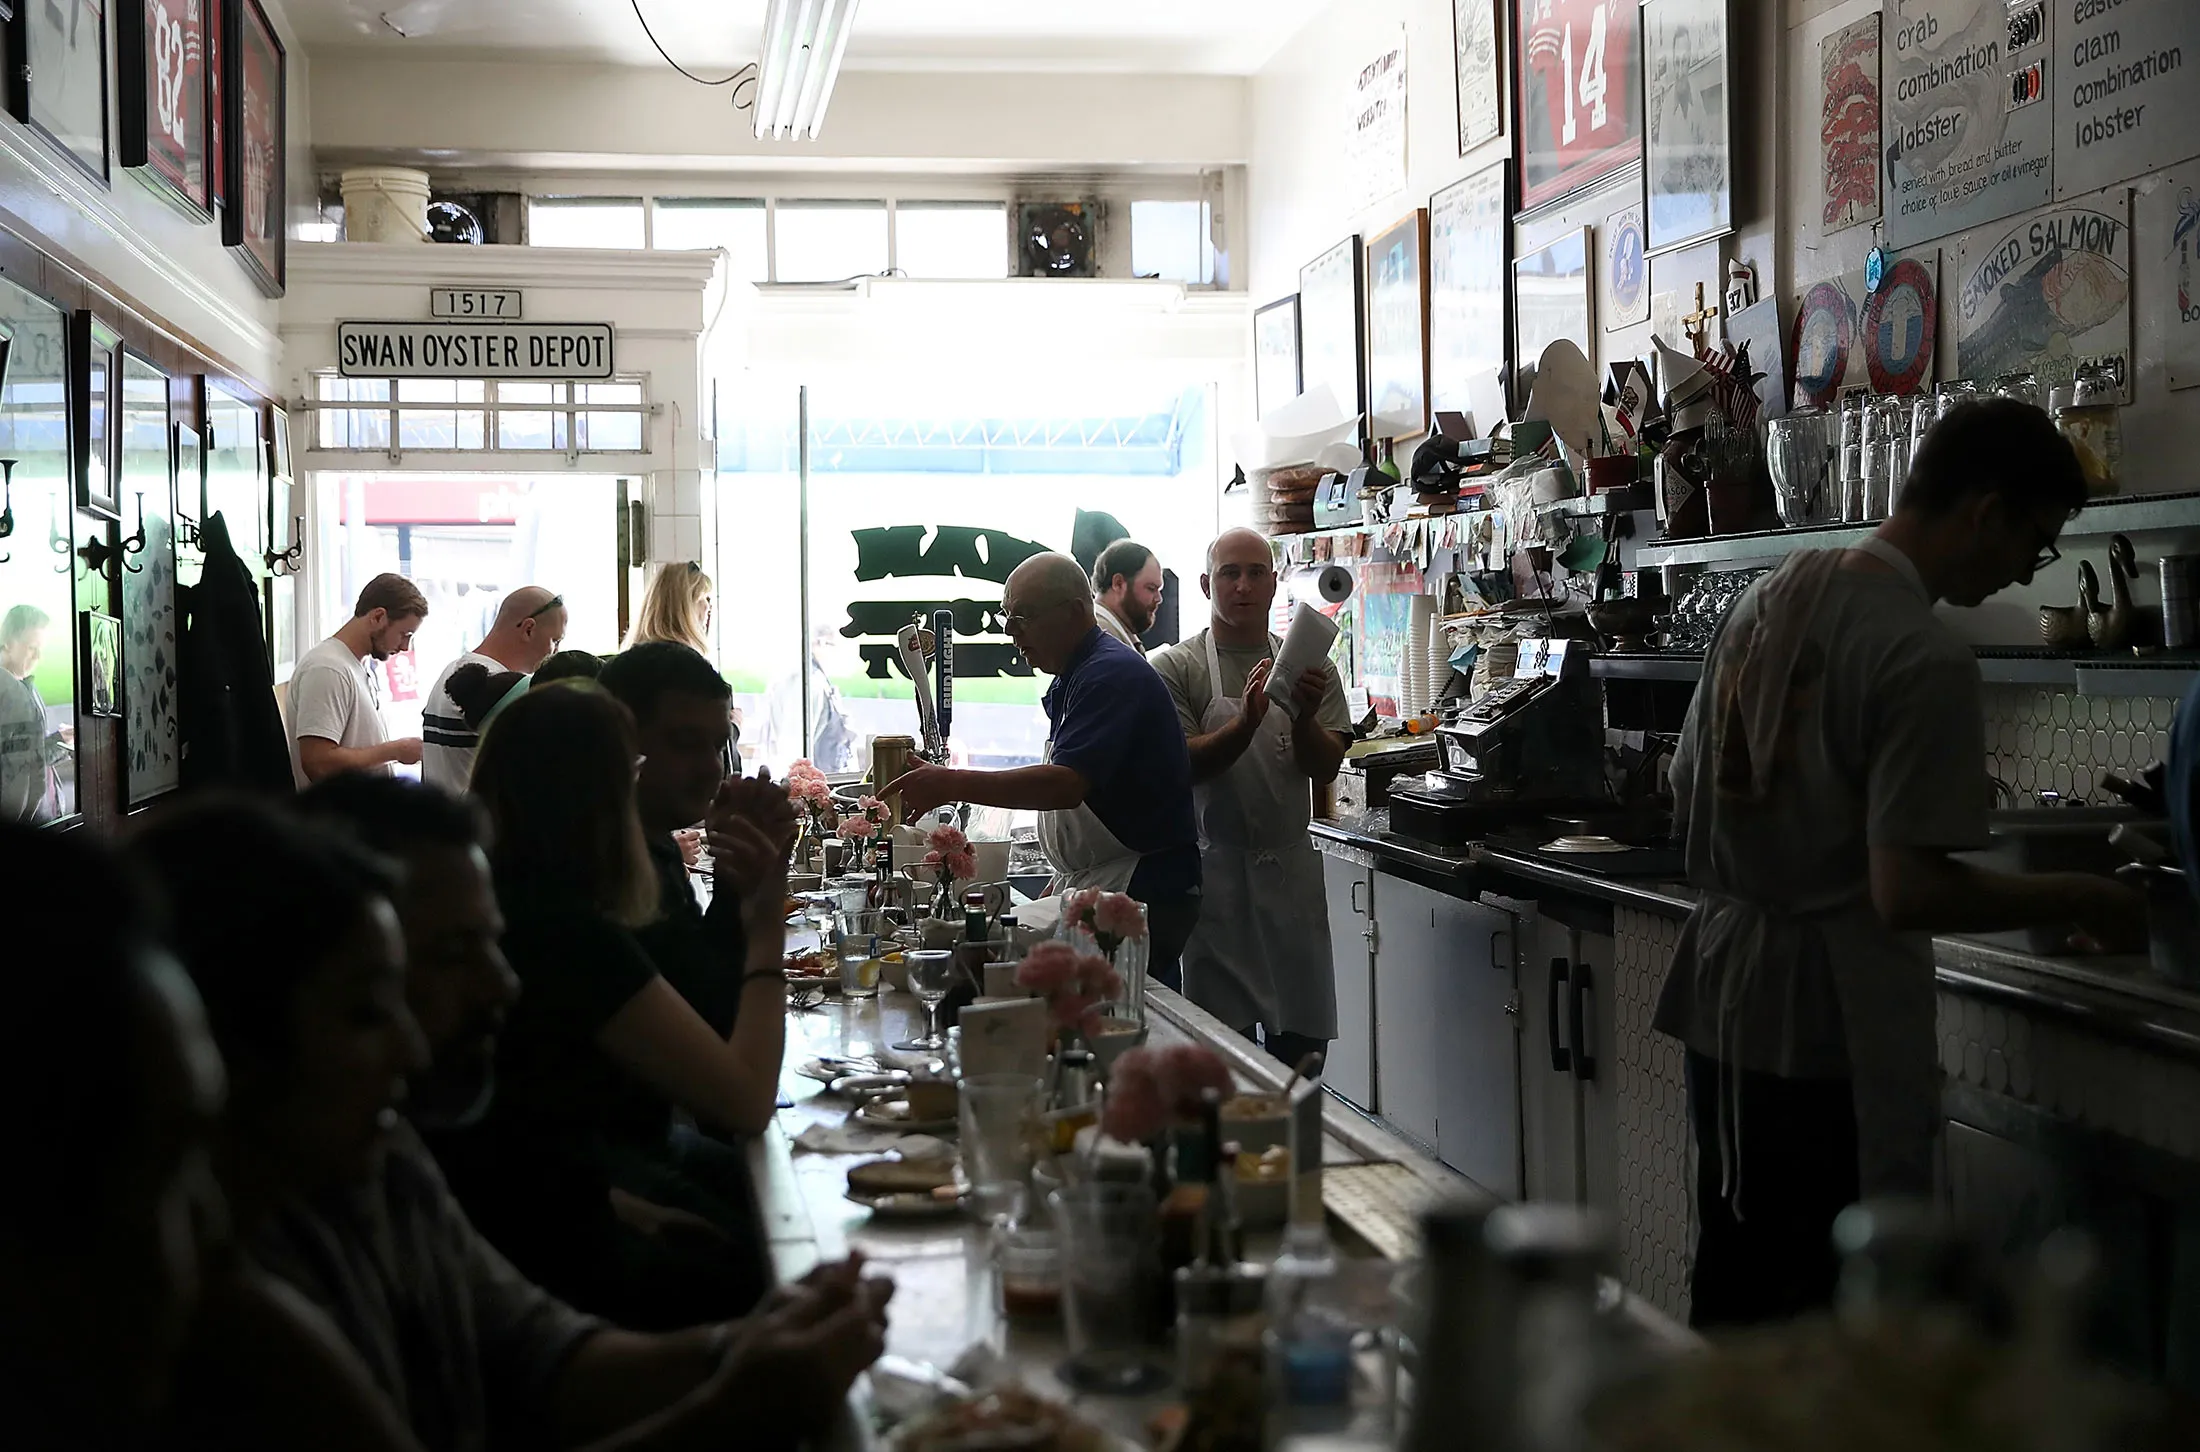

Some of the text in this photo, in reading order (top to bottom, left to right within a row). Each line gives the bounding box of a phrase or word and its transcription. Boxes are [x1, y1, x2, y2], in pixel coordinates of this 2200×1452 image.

[1897, 12, 1938, 51] crab
[2073, 29, 2120, 68] clam
[1561, 3, 1608, 146] 14
[1898, 40, 1999, 102] combination
[2073, 46, 2182, 109] combination
[1899, 111, 1961, 154] lobster
[2075, 104, 2146, 149] lobster
[1901, 173, 1928, 193] served
[1948, 154, 1973, 176] bread
[1976, 148, 1991, 168] and
[1994, 139, 2022, 160] butter
[1901, 195, 1927, 215] choice
[1963, 174, 1988, 196] sauce
[1990, 171, 2000, 186] or
[1962, 214, 2119, 321] SMOKED SALMON
[447, 292, 507, 315] 1517
[1728, 288, 1741, 311] 37
[343, 333, 605, 367] SWAN OYSTER DEPOT
